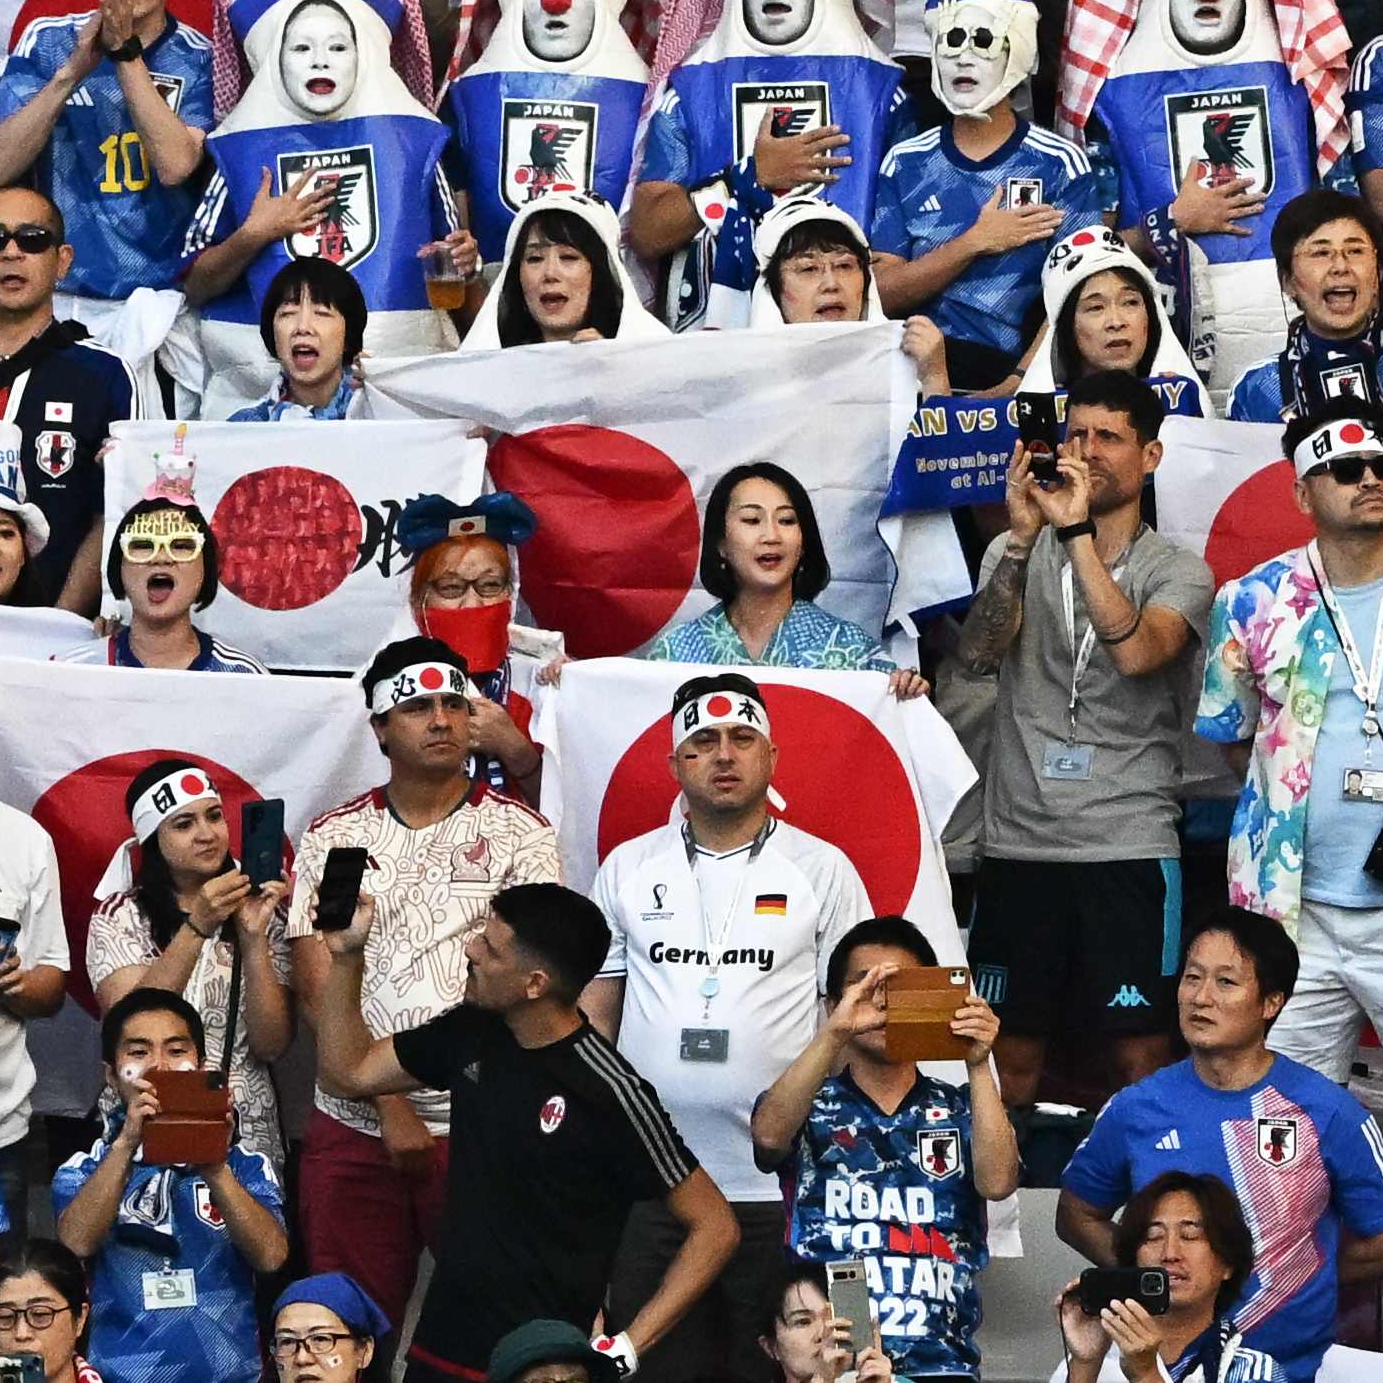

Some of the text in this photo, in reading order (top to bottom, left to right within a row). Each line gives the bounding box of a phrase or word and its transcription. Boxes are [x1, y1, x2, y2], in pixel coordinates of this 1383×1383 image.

[756, 87, 806, 100] JAPAN
[1190, 92, 1243, 109] JAPAN
[521, 104, 575, 118] JAPAN
[99, 131, 151, 194] 10
[301, 153, 352, 169] JAPAN
[957, 408, 998, 433] vs
[916, 450, 1009, 474] November
[950, 462, 1009, 490] at Al-
[125, 521, 201, 536] BIRTHDAY
[134, 510, 189, 524] HAPPY
[681, 697, 762, 733] 日本
[648, 940, 775, 972] Germany
[824, 1178, 936, 1225] ROAD
[828, 1223, 880, 1249] TO
[863, 1254, 956, 1303] ATAR
